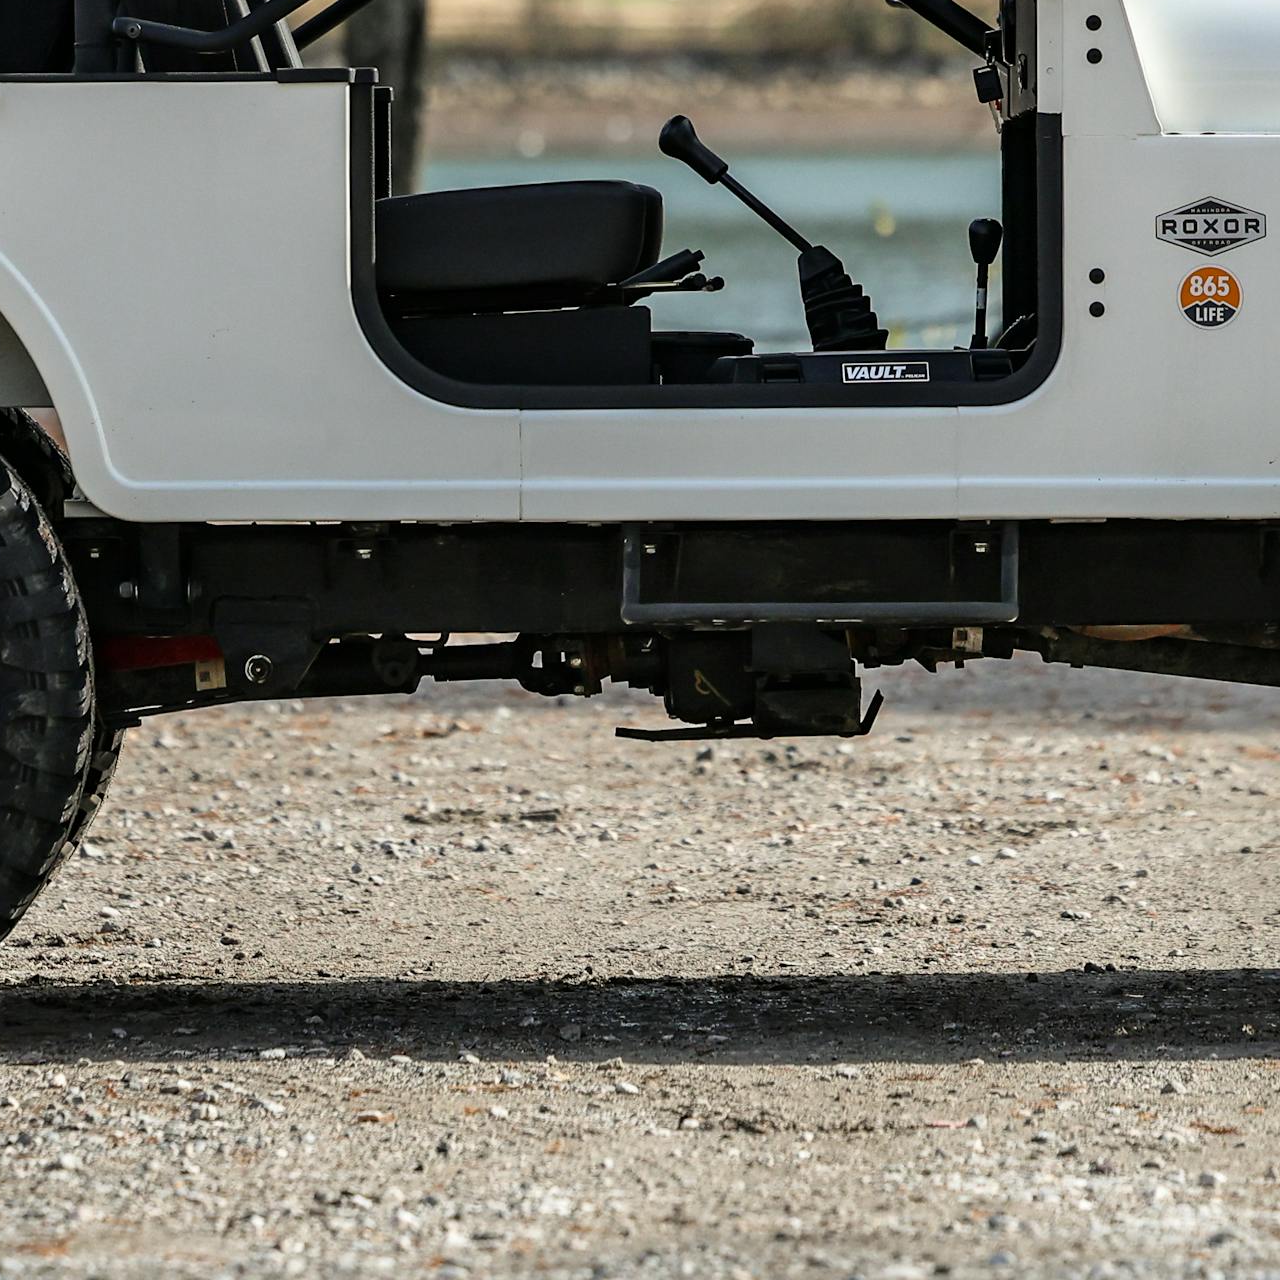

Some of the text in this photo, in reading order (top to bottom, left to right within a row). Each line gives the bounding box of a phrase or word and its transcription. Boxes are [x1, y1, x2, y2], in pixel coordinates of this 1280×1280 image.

[1162, 219, 1260, 234] ROXOR
[1190, 275, 1230, 297] 865
[1195, 307, 1225, 322] LIFE
[846, 366, 906, 379] VAULT
